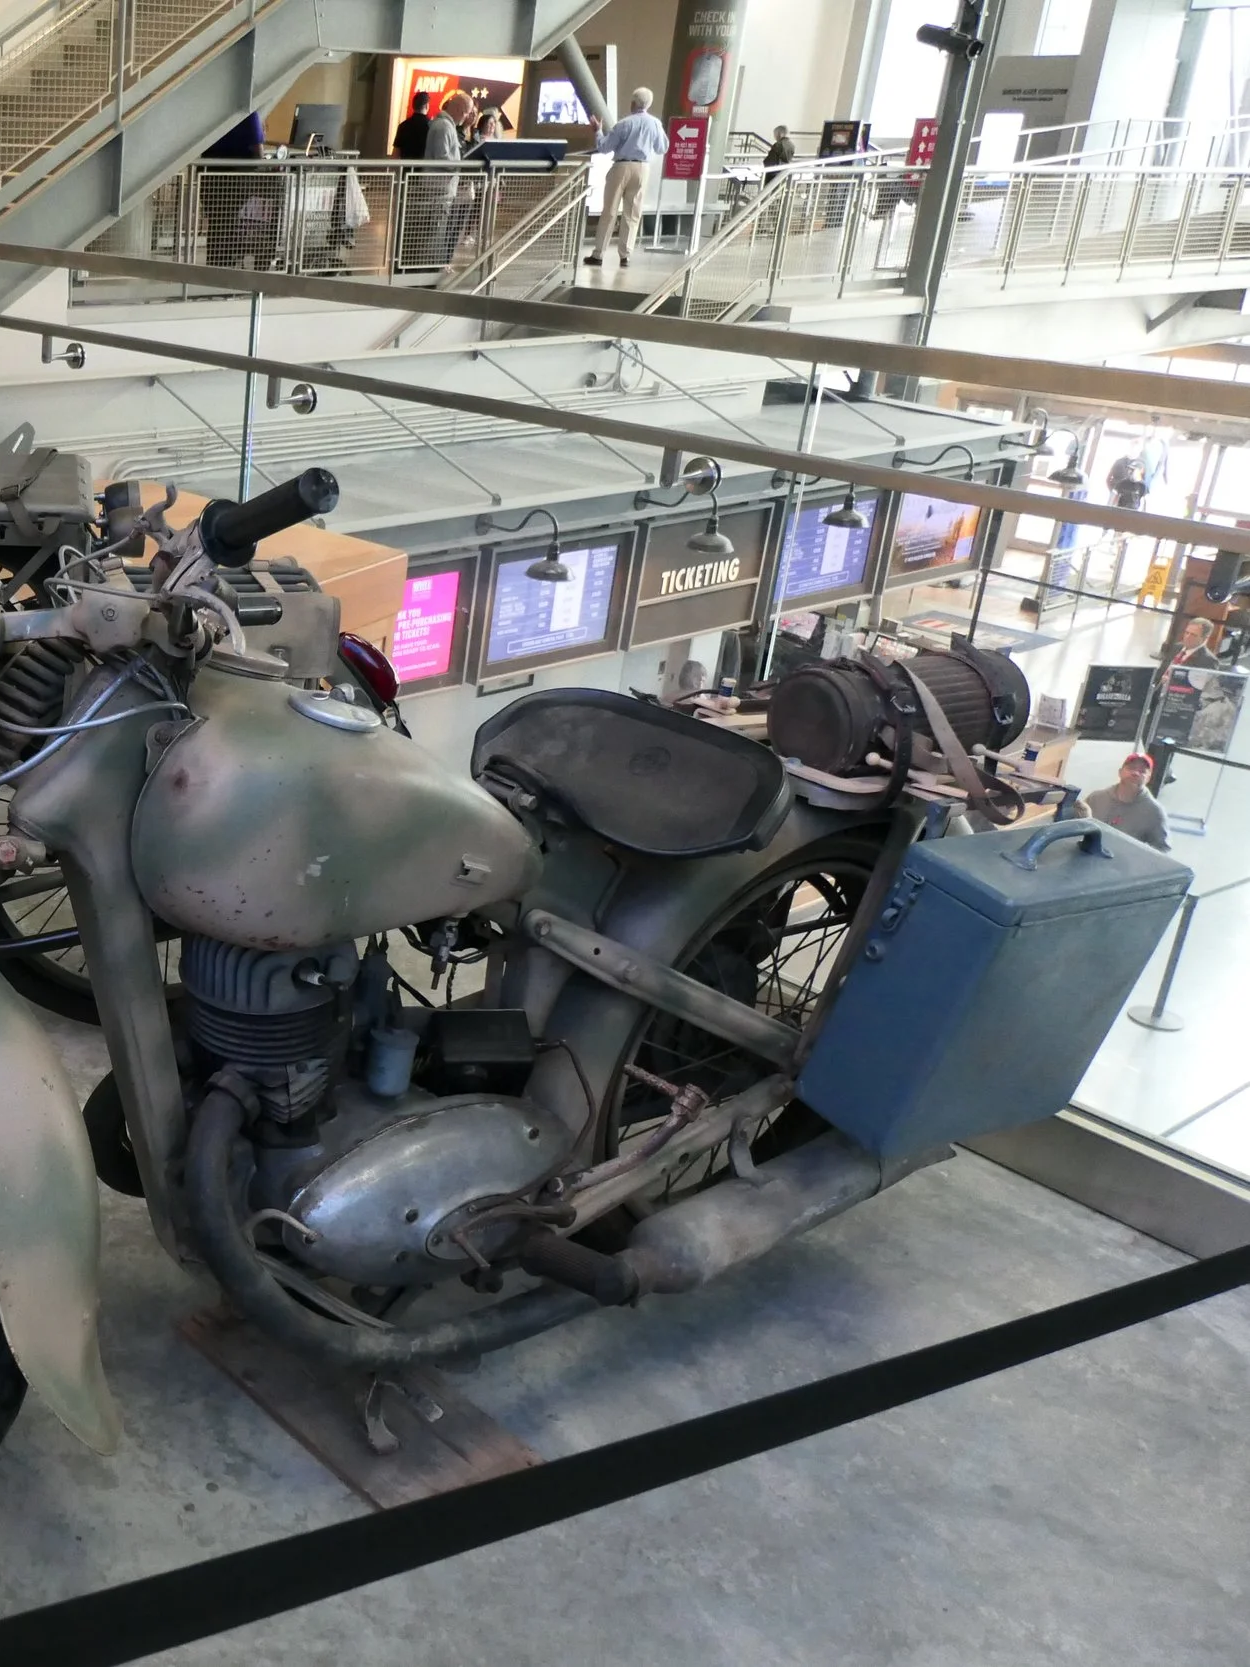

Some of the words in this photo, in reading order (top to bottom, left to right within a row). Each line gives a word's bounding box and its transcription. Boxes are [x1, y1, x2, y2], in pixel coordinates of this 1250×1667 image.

[694, 11, 725, 23] CHECK
[689, 24, 712, 36] WITH
[414, 76, 448, 93] ARMY
[661, 557, 740, 595] TICKETING
[408, 607, 421, 618] YOU
[398, 612, 452, 630] PRE-PURCHASING
